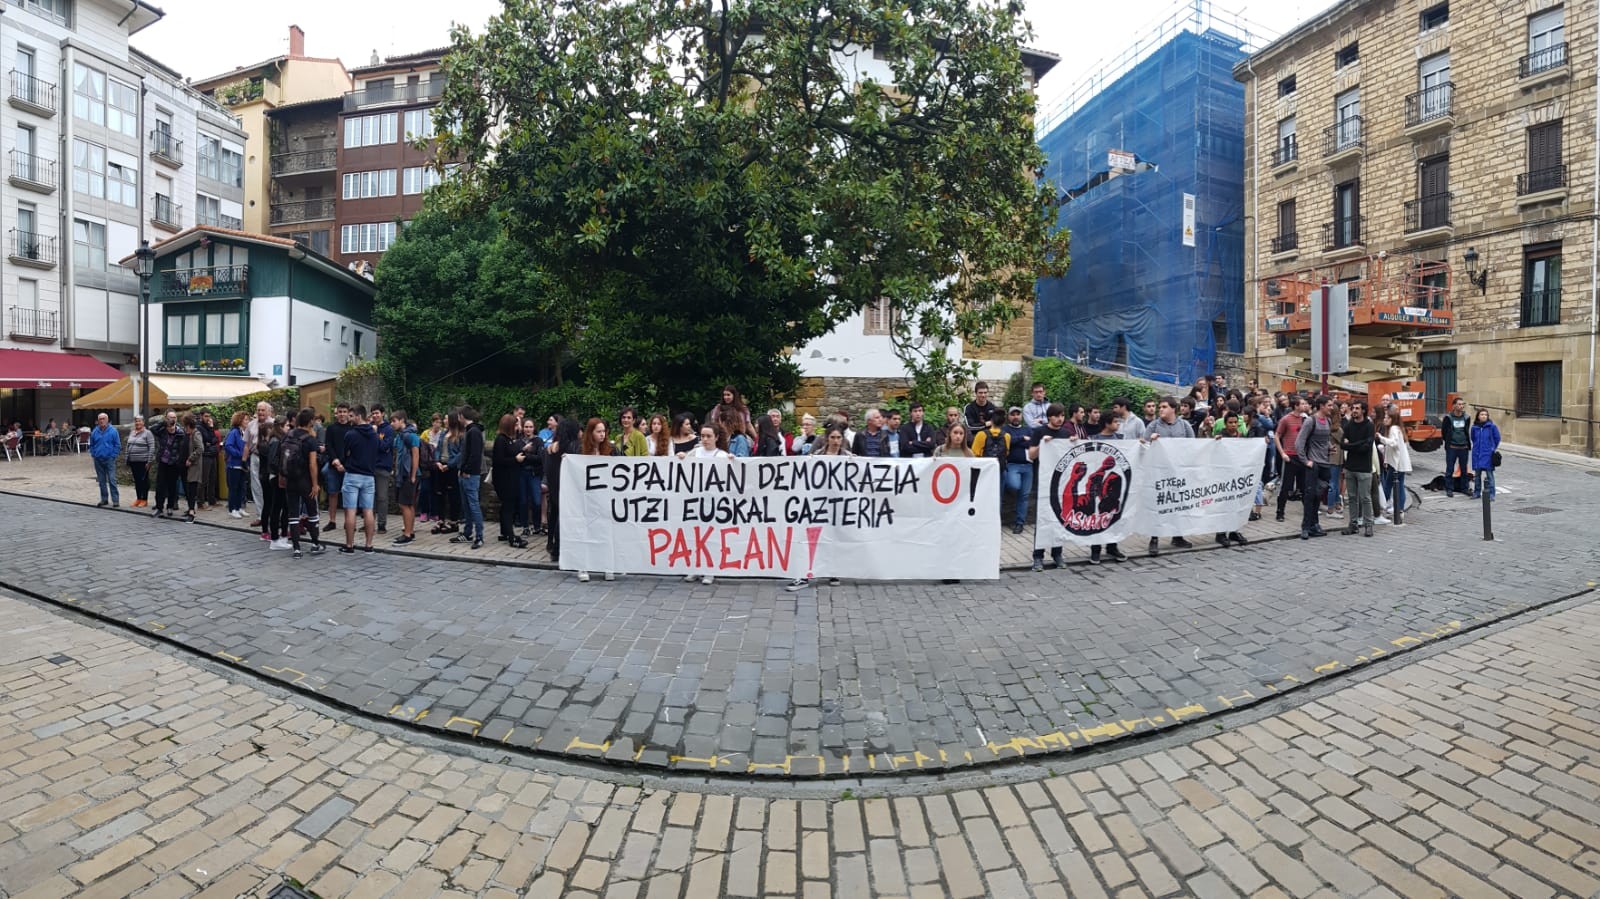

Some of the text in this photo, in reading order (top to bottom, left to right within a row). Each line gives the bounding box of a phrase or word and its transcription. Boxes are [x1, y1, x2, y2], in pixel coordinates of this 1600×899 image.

[585, 461, 746, 494] ESPAINIAN
[758, 460, 920, 496] DEMOKRAZIA
[1155, 477, 1187, 490] ETXERA
[611, 496, 894, 528] UTZI EUSKAL GAZTERIA
